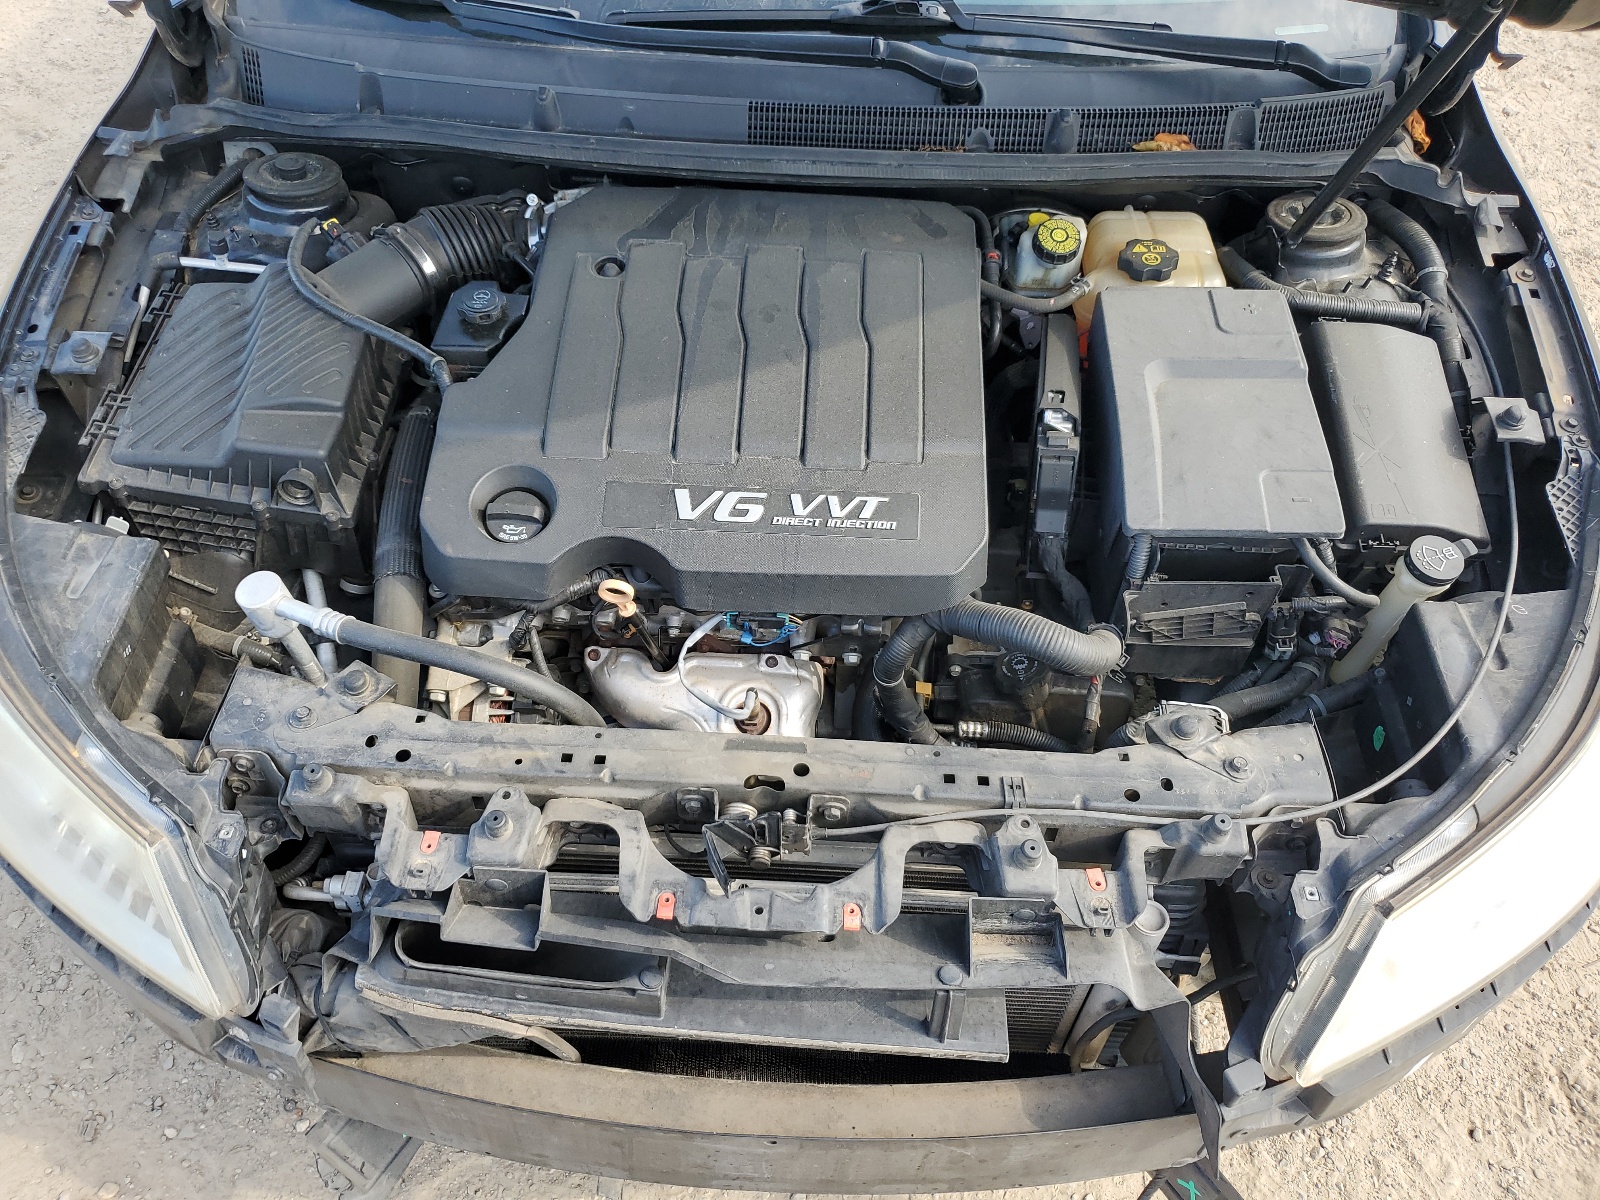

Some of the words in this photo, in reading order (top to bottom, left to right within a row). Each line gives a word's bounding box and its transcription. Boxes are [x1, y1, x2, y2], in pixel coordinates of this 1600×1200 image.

[674, 488, 768, 523] V6
[789, 493, 890, 519] VVT
[771, 516, 823, 528] DIRECT
[826, 518, 897, 530] INJECTION
